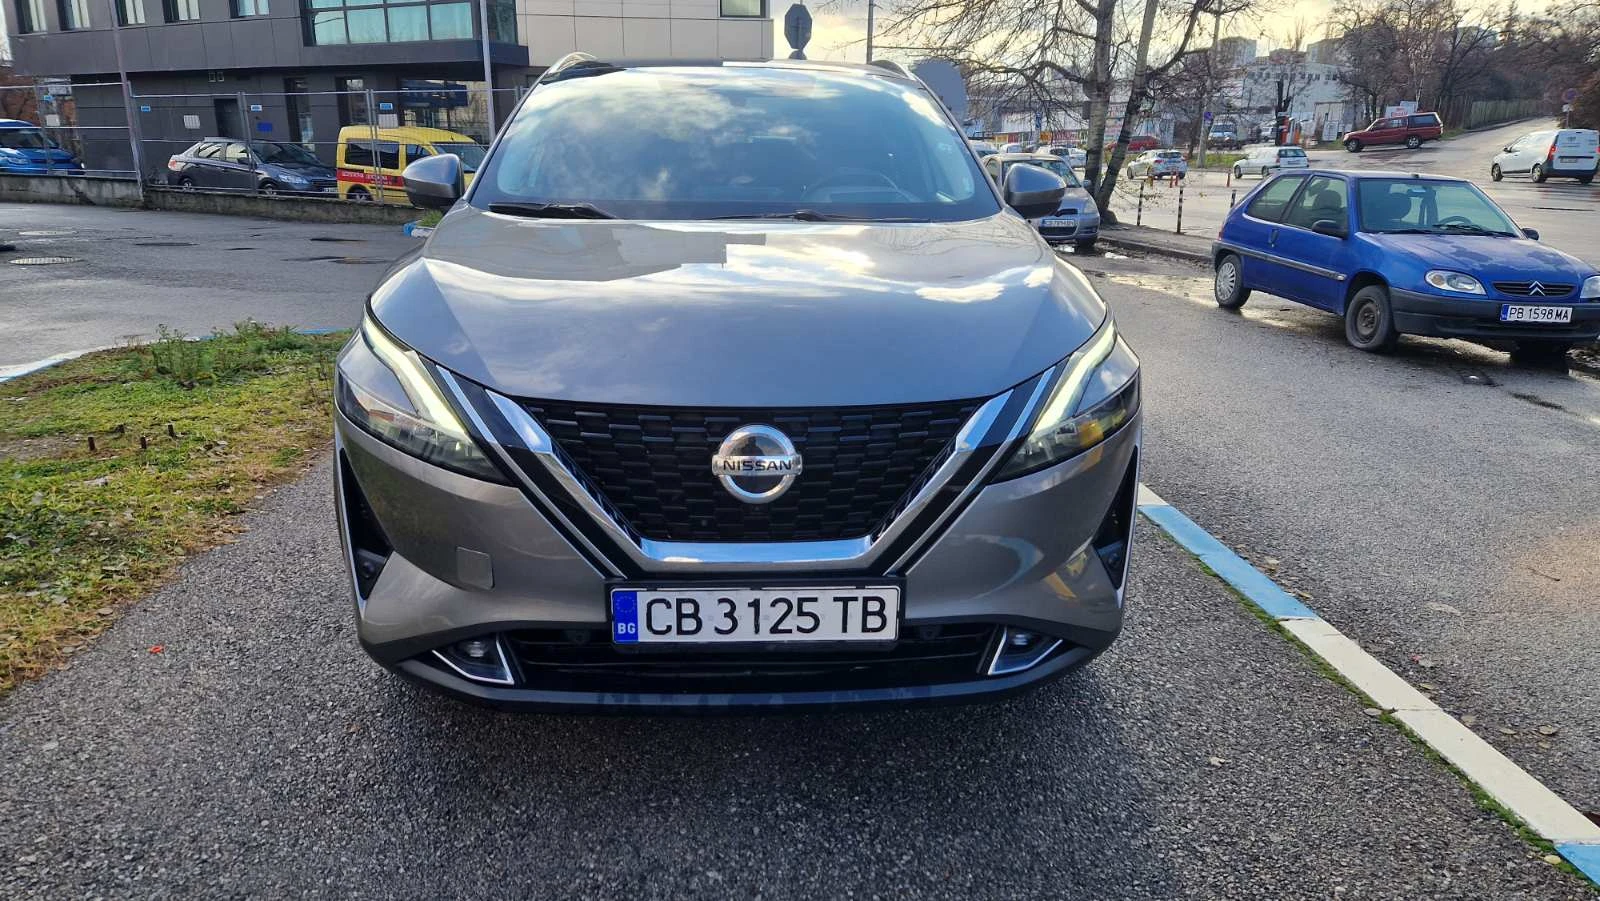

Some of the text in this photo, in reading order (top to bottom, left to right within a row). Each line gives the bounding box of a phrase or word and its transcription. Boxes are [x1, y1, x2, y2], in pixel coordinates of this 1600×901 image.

[1509, 307, 1569, 321] PB 1598 MA
[723, 459, 793, 472] NISSAN
[645, 595, 888, 636] CB 3125 TB
[617, 623, 636, 635] BG
